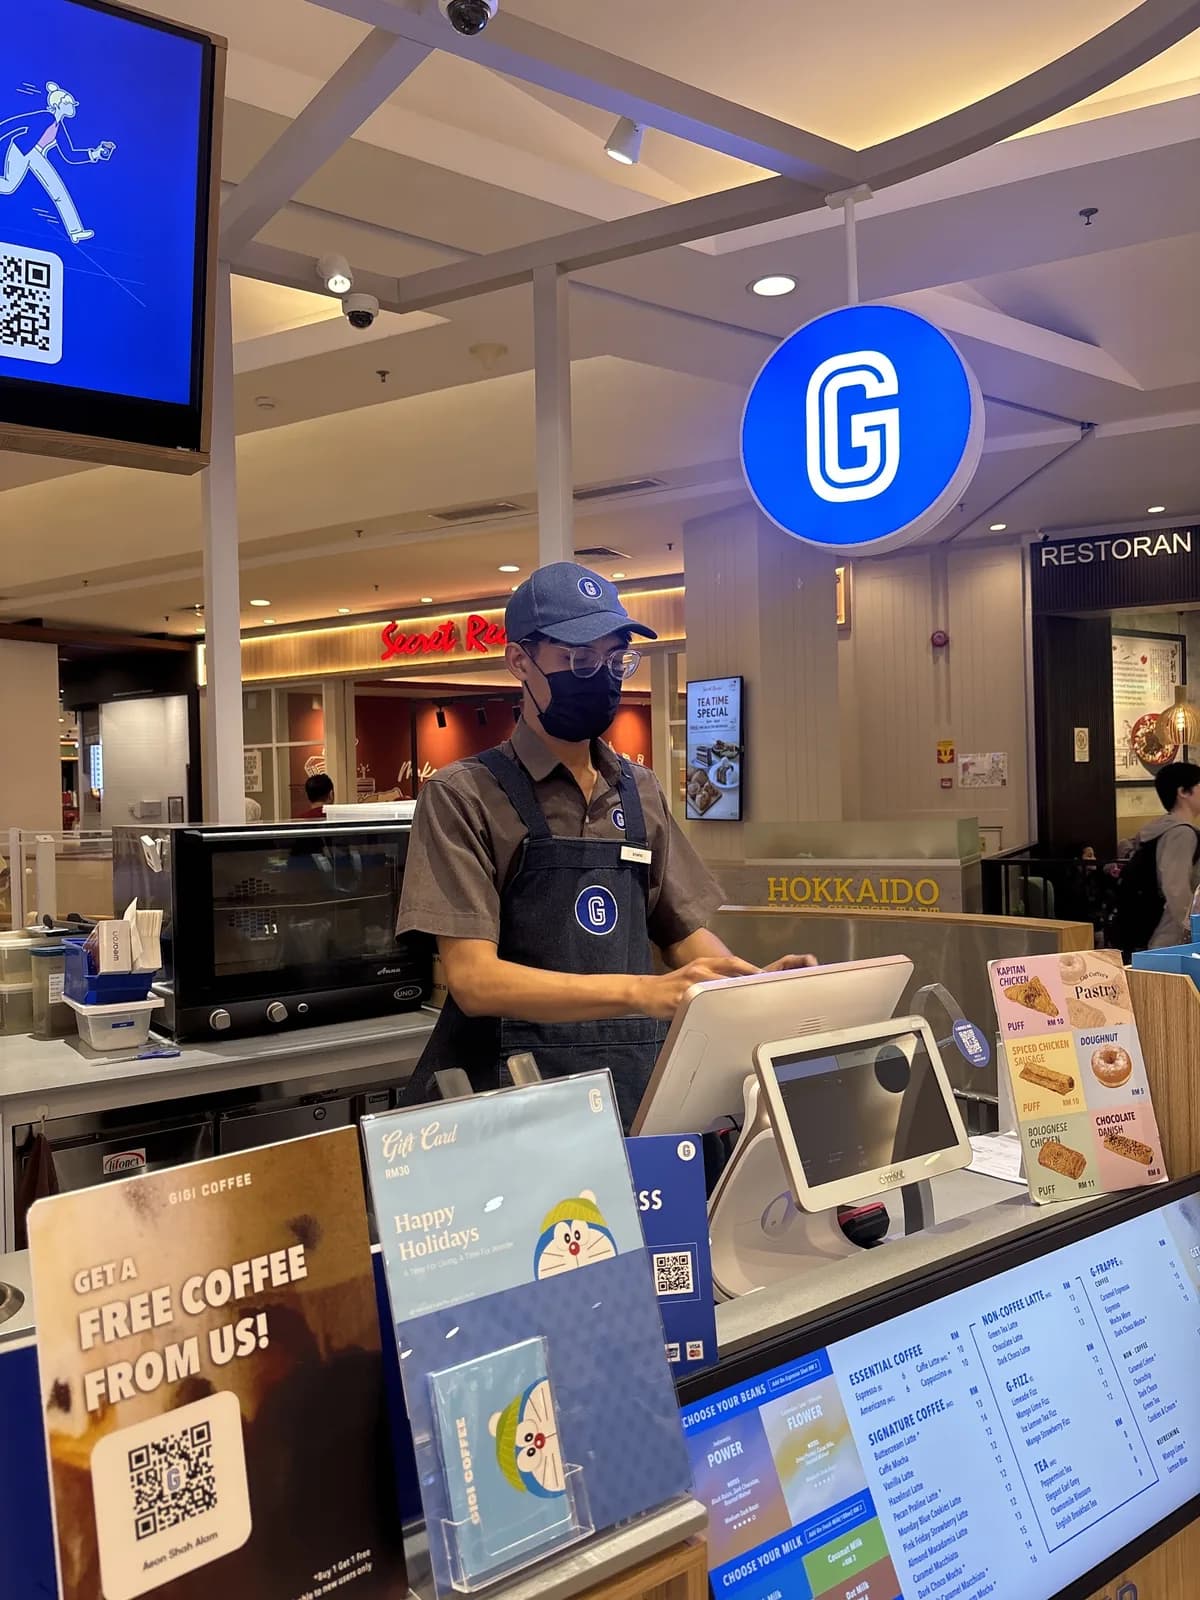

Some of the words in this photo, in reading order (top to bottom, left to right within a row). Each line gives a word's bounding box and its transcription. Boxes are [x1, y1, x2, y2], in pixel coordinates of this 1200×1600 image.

[806, 350, 900, 503] G
[1041, 532, 1192, 567] RESTORAN
[381, 620, 458, 660] Secret
[465, 614, 506, 653] Rec
[697, 697, 711, 708] TEA
[712, 696, 729, 705] TIME
[697, 707, 729, 719] SPECIAL
[767, 877, 940, 905] HOKKAIDO
[588, 896, 606, 926] G
[996, 965, 1026, 977] KAPITAN
[999, 975, 1029, 987] CHICKEN
[1074, 984, 1118, 1000] Pastry
[1007, 1021, 1025, 1031] PUFF
[1012, 1044, 1037, 1056] SPICED
[1038, 1040, 1070, 1051] CHICKEN
[1080, 1032, 1118, 1046] DOUGHNUT
[1014, 1054, 1046, 1066] SAUSAGE
[588, 1088, 603, 1113] G
[1023, 1101, 1041, 1113] PUFF
[1062, 1099, 1072, 1107] RM
[1072, 1098, 1080, 1106] 10
[1028, 1122, 1068, 1137] BOLOGNESE
[1096, 1112, 1136, 1126] CHOCOLATE
[1098, 1125, 1124, 1137] DANISH
[381, 1129, 415, 1162] Gift
[420, 1121, 457, 1151] Card
[385, 1165, 410, 1180] RM30
[168, 1188, 197, 1205] GIGI
[201, 1173, 252, 1197] COFFEE
[638, 1189, 663, 1211] SS
[1038, 1185, 1056, 1197] PUFF
[393, 1205, 455, 1234] Happy
[399, 1226, 480, 1262] Holidays
[74, 1262, 117, 1294] GET
[120, 1256, 138, 1281] A
[78, 1285, 174, 1350] FREE
[181, 1244, 308, 1316] COFFEE
[982, 1299, 1025, 1327] NON-COFFEE
[1024, 1290, 1045, 1306] LATTE
[84, 1337, 201, 1412] FROM
[208, 1312, 270, 1366] US!
[849, 1358, 893, 1387] ESSENTIAL
[893, 1343, 923, 1366] COFFEE
[1005, 1373, 1029, 1392] G-FIZZ
[682, 1405, 717, 1428] CHOOSE
[716, 1395, 739, 1413] YOUR
[741, 1383, 767, 1403] BEANS
[787, 1404, 823, 1430] FLOWER
[868, 1413, 915, 1446] SIGNATURE
[916, 1399, 945, 1422] COFFEE
[456, 1417, 474, 1483] COFFEE
[904, 1434, 917, 1446] Latte
[707, 1440, 744, 1468] POWER
[1034, 1458, 1049, 1474] TEA
[166, 1468, 181, 1491] G
[901, 1470, 914, 1482] Latte
[925, 1491, 939, 1504] Latte
[898, 1521, 919, 1537] Monday
[918, 1513, 930, 1525] Blue
[930, 1503, 950, 1519] Cookies
[949, 1496, 962, 1509] Latte
[903, 1540, 915, 1552] Pink
[914, 1531, 931, 1546] Friday
[930, 1516, 957, 1537] Strawberry
[956, 1509, 968, 1522] Latte
[142, 1553, 167, 1571] Aeon
[168, 1542, 193, 1560] Shah
[195, 1531, 218, 1547] Alam
[338, 1558, 350, 1570] Get
[356, 1549, 371, 1561] Free
[908, 1550, 928, 1568] Almond
[955, 1527, 968, 1540] Latte
[722, 1559, 757, 1587] CHOOSE
[757, 1548, 781, 1568] YOUR
[781, 1536, 803, 1556] MILK
[912, 1564, 934, 1584] Caramel
[314, 1588, 322, 1598] to
[322, 1581, 337, 1593] new
[338, 1571, 356, 1585] users
[357, 1562, 373, 1576] only
[917, 1586, 930, 1599] Dark
[945, 1566, 962, 1581] Mocha
